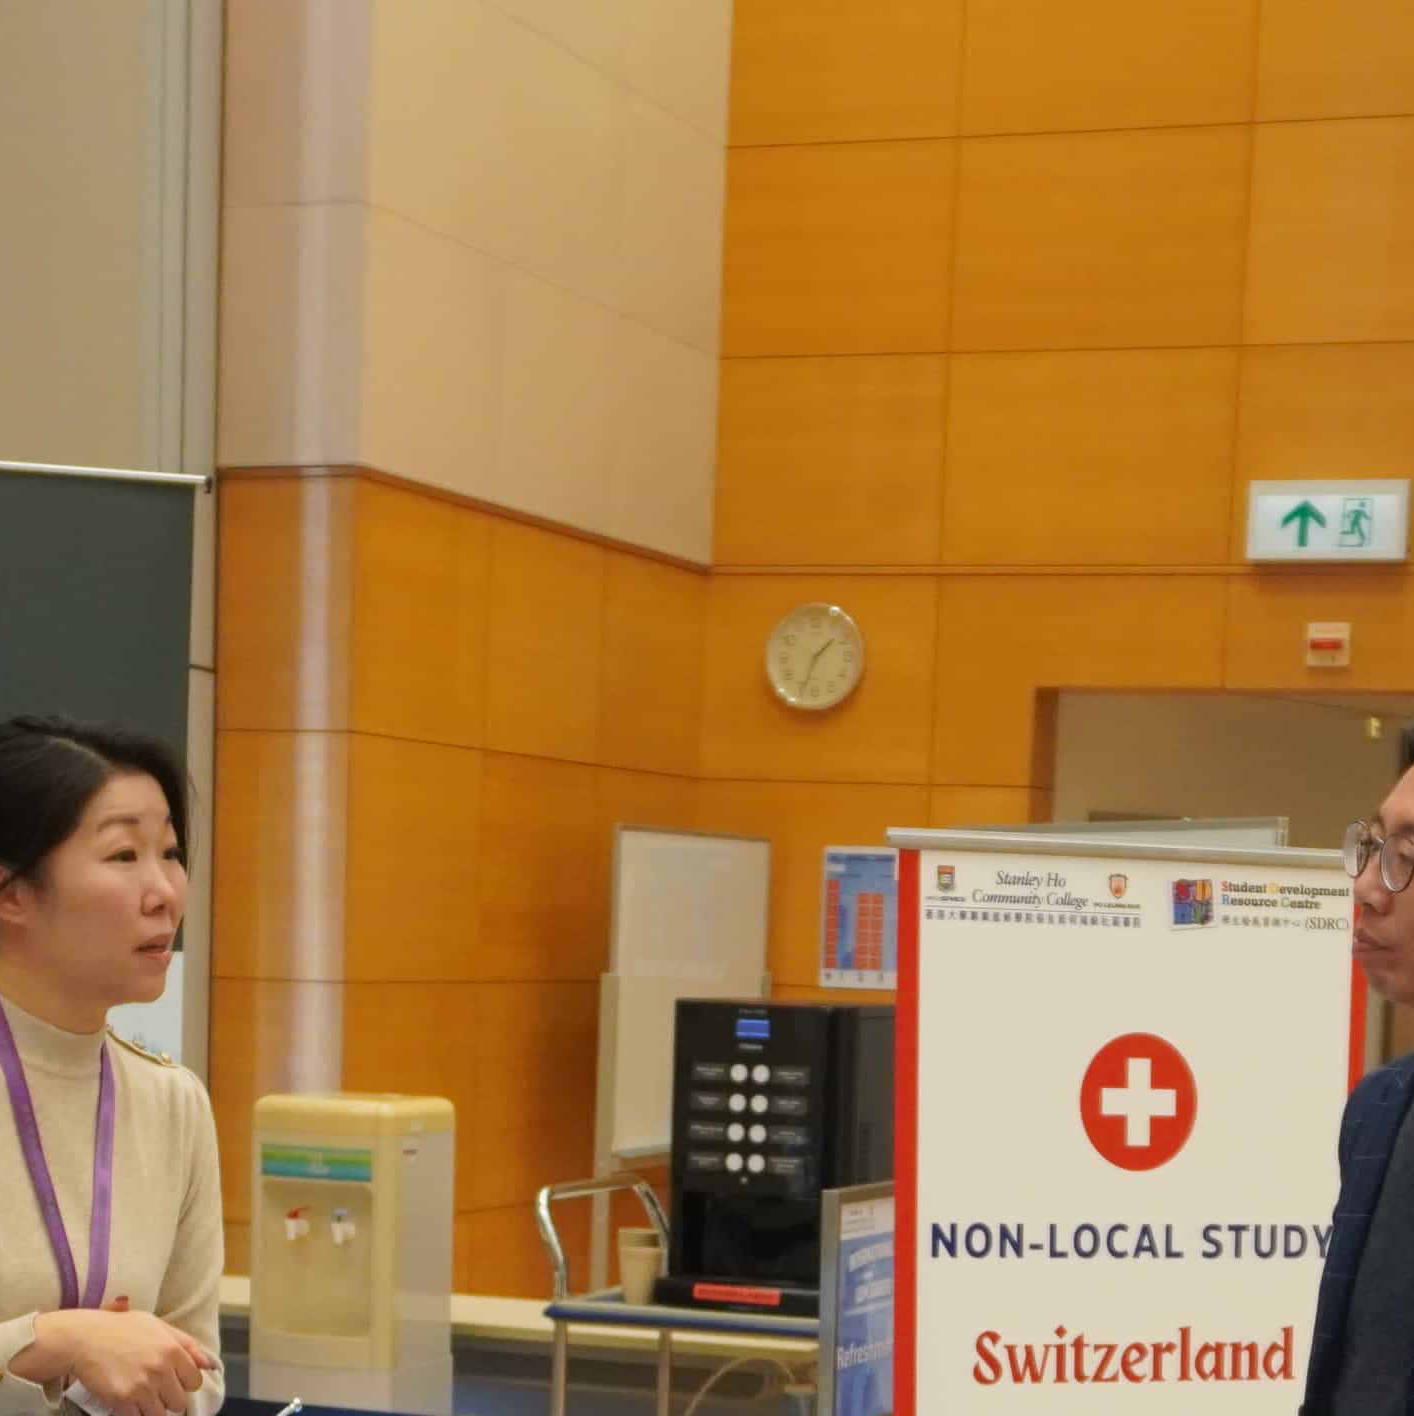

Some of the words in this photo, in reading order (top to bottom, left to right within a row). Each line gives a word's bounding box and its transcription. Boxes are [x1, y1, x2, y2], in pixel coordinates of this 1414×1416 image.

[995, 869, 1043, 889] Stanley
[1046, 872, 1067, 889] Ho
[1221, 880, 1267, 894] Student
[1268, 882, 1349, 897] Development
[971, 889, 1044, 908] Community
[1046, 892, 1089, 911] College
[1221, 894, 1278, 908] Resource
[1281, 896, 1322, 910] Centre
[1304, 915, 1350, 932] (SDRC)
[930, 1221, 1184, 1260] NON-LOCAL
[1200, 1222, 1334, 1260] STUDY
[971, 1324, 1295, 1386] Switzerland
